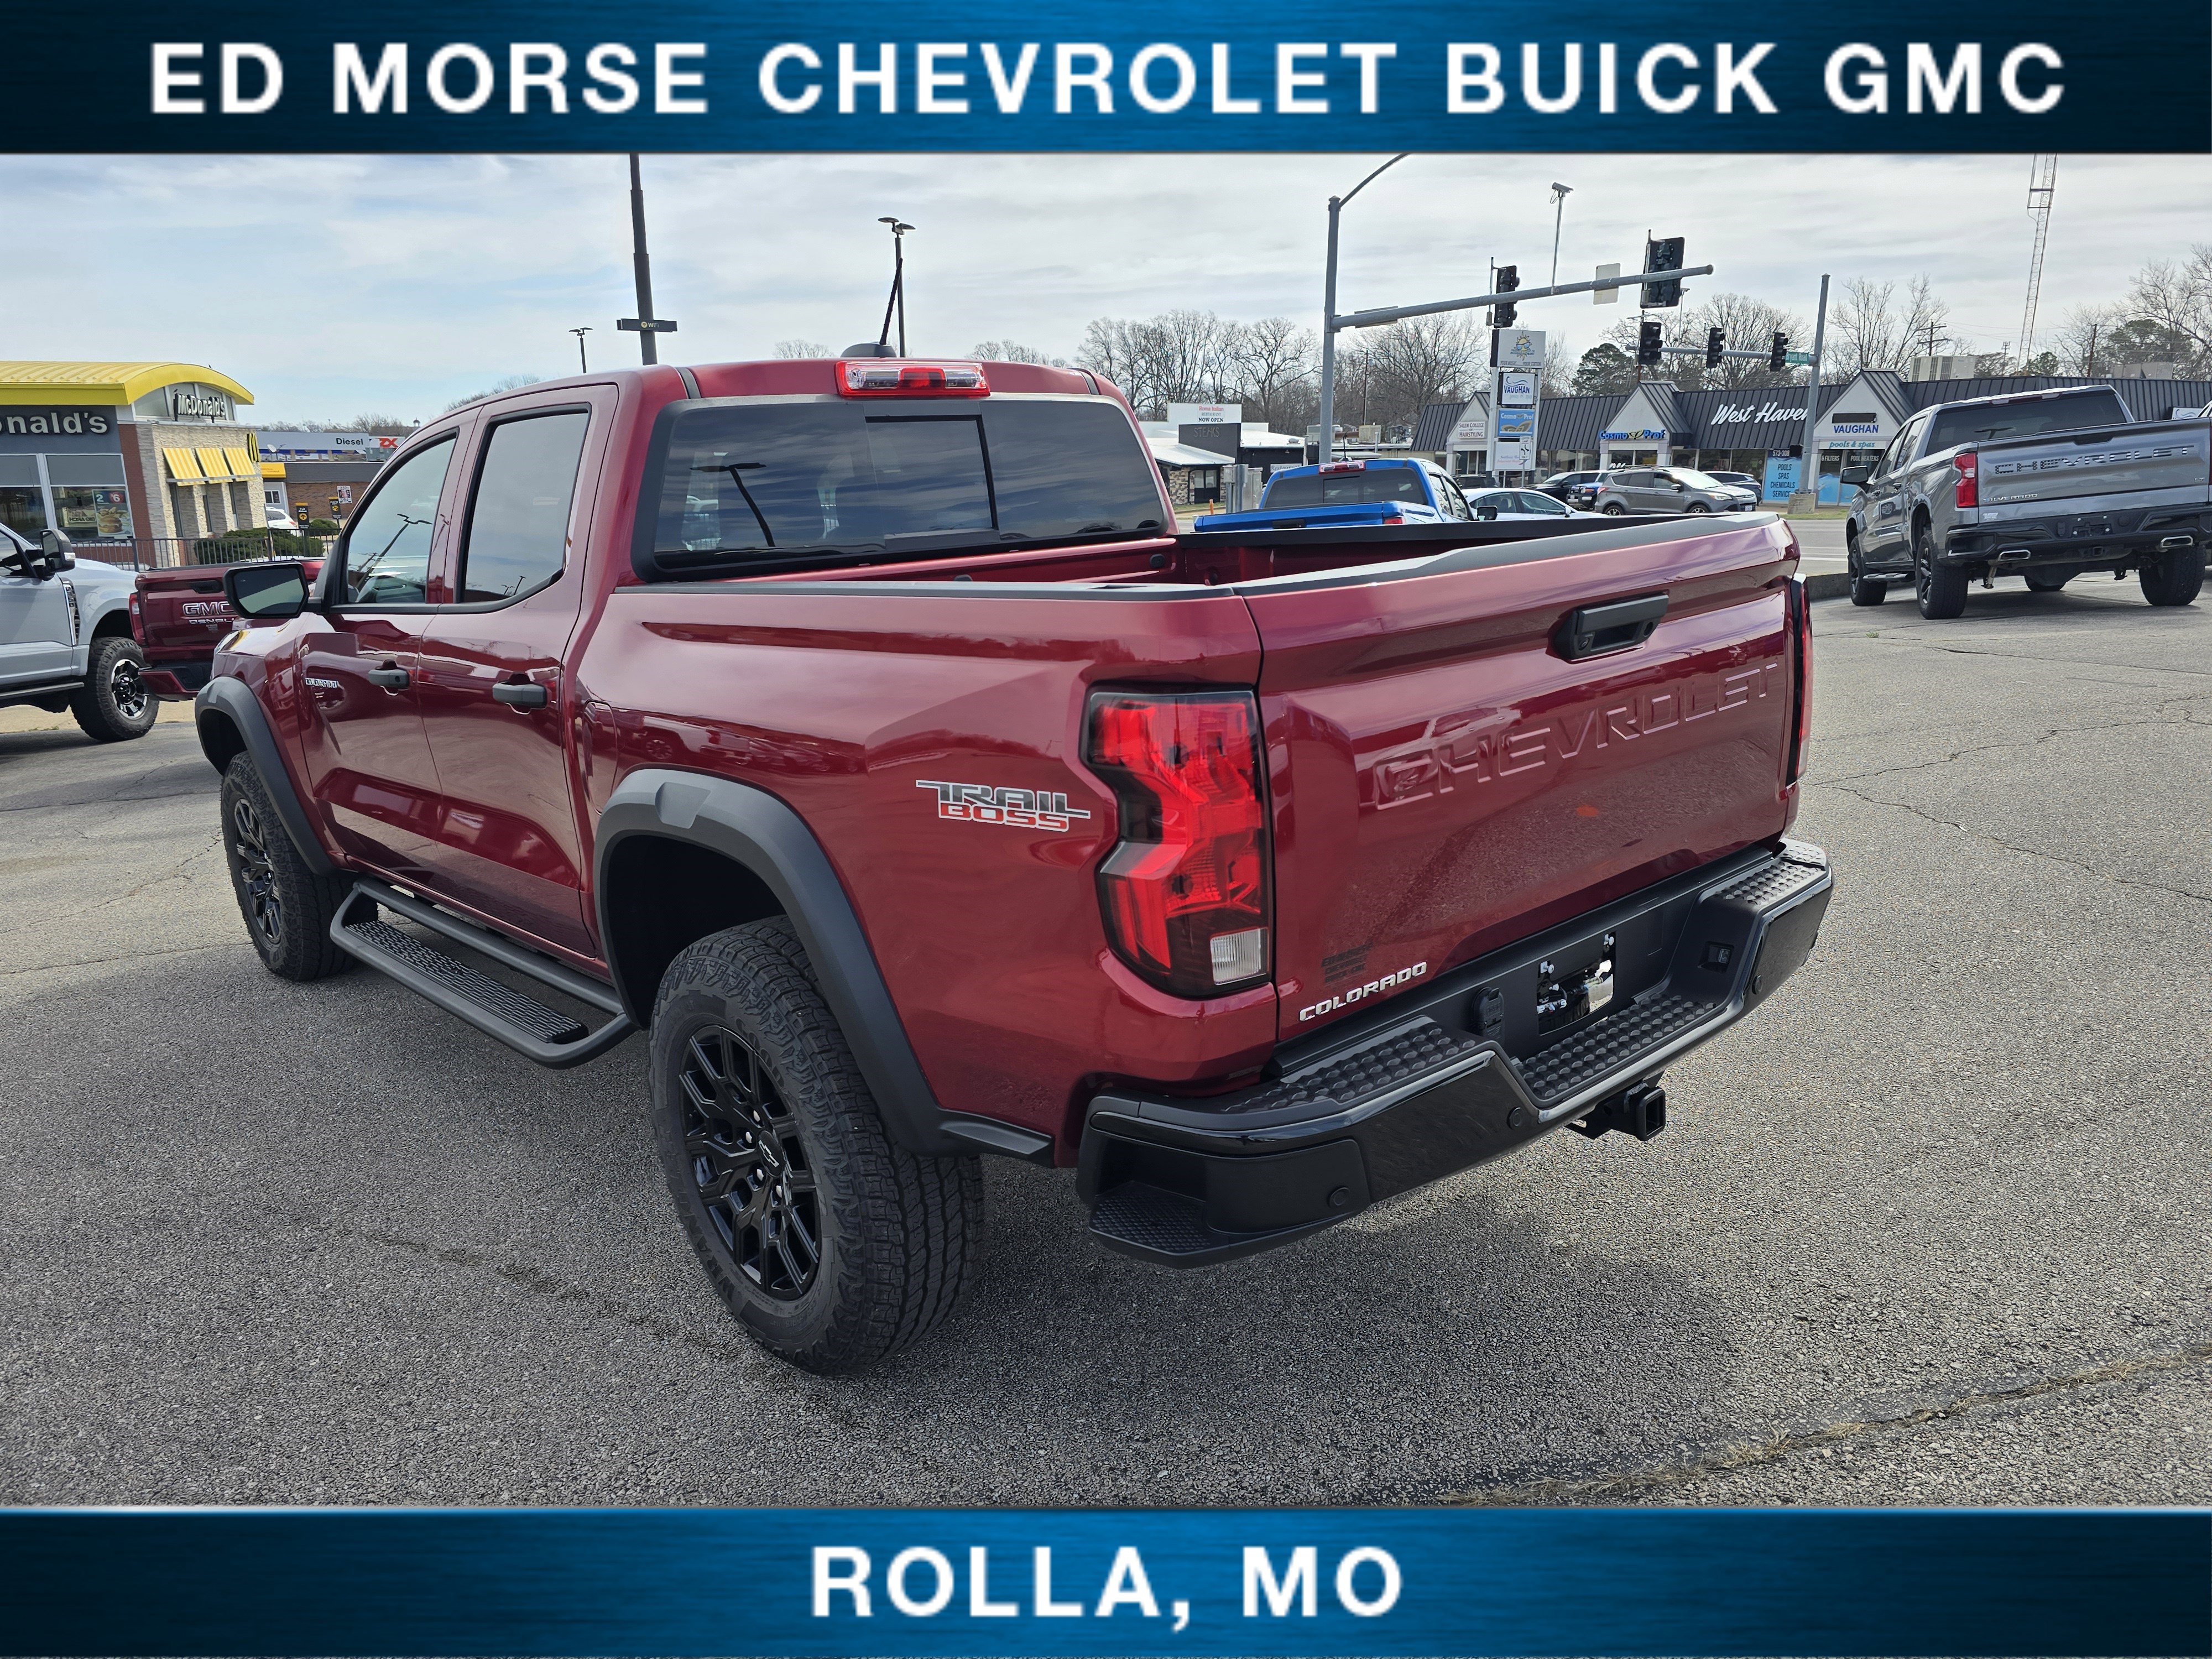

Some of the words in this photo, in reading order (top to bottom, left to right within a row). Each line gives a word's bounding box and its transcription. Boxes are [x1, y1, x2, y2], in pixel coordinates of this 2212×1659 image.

[0, 413, 108, 434] nald's
[1711, 404, 1755, 425] West
[1599, 430, 1628, 440] Cosmo
[1644, 429, 1666, 439] Prof
[1834, 425, 1879, 433] VAUGHAN
[1829, 441, 1849, 449] pools
[1995, 444, 2194, 474] CHEVROLET
[96, 494, 104, 502] 2
[1983, 493, 2038, 502] SILVERADO
[182, 601, 237, 616] GMC
[1373, 662, 1778, 810] CHEVROLET
[916, 780, 1091, 819] TRAIL
[938, 802, 1069, 832] BOSS
[1300, 962, 1427, 1021] COLORADO
